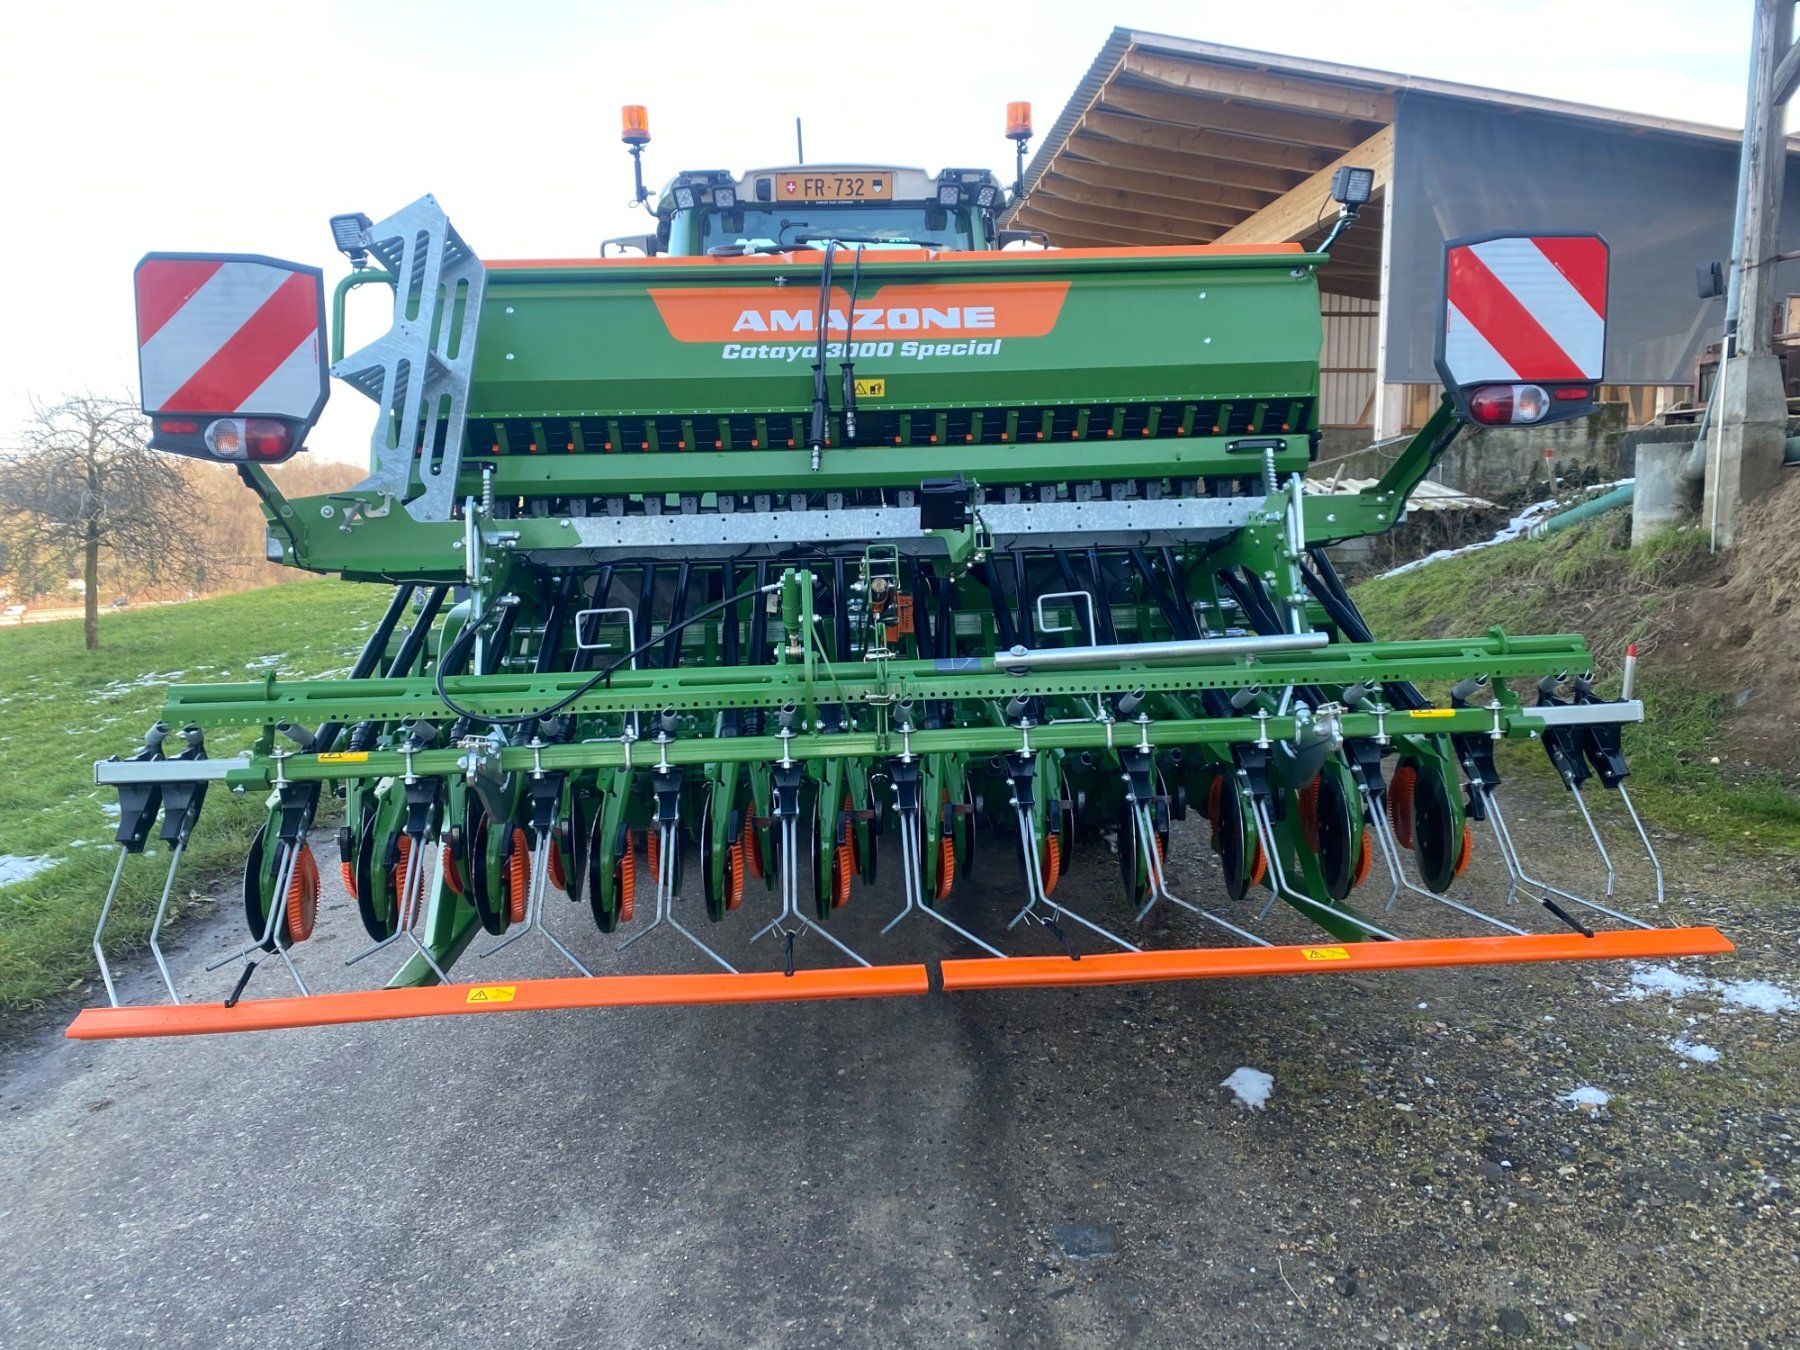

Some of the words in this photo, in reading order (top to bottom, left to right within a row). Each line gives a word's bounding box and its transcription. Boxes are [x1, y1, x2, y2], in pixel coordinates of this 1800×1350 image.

[732, 306, 996, 332] AMAZONE
[722, 344, 818, 362] Cataya
[825, 342, 895, 358] 3000
[900, 339, 1002, 360] Special
